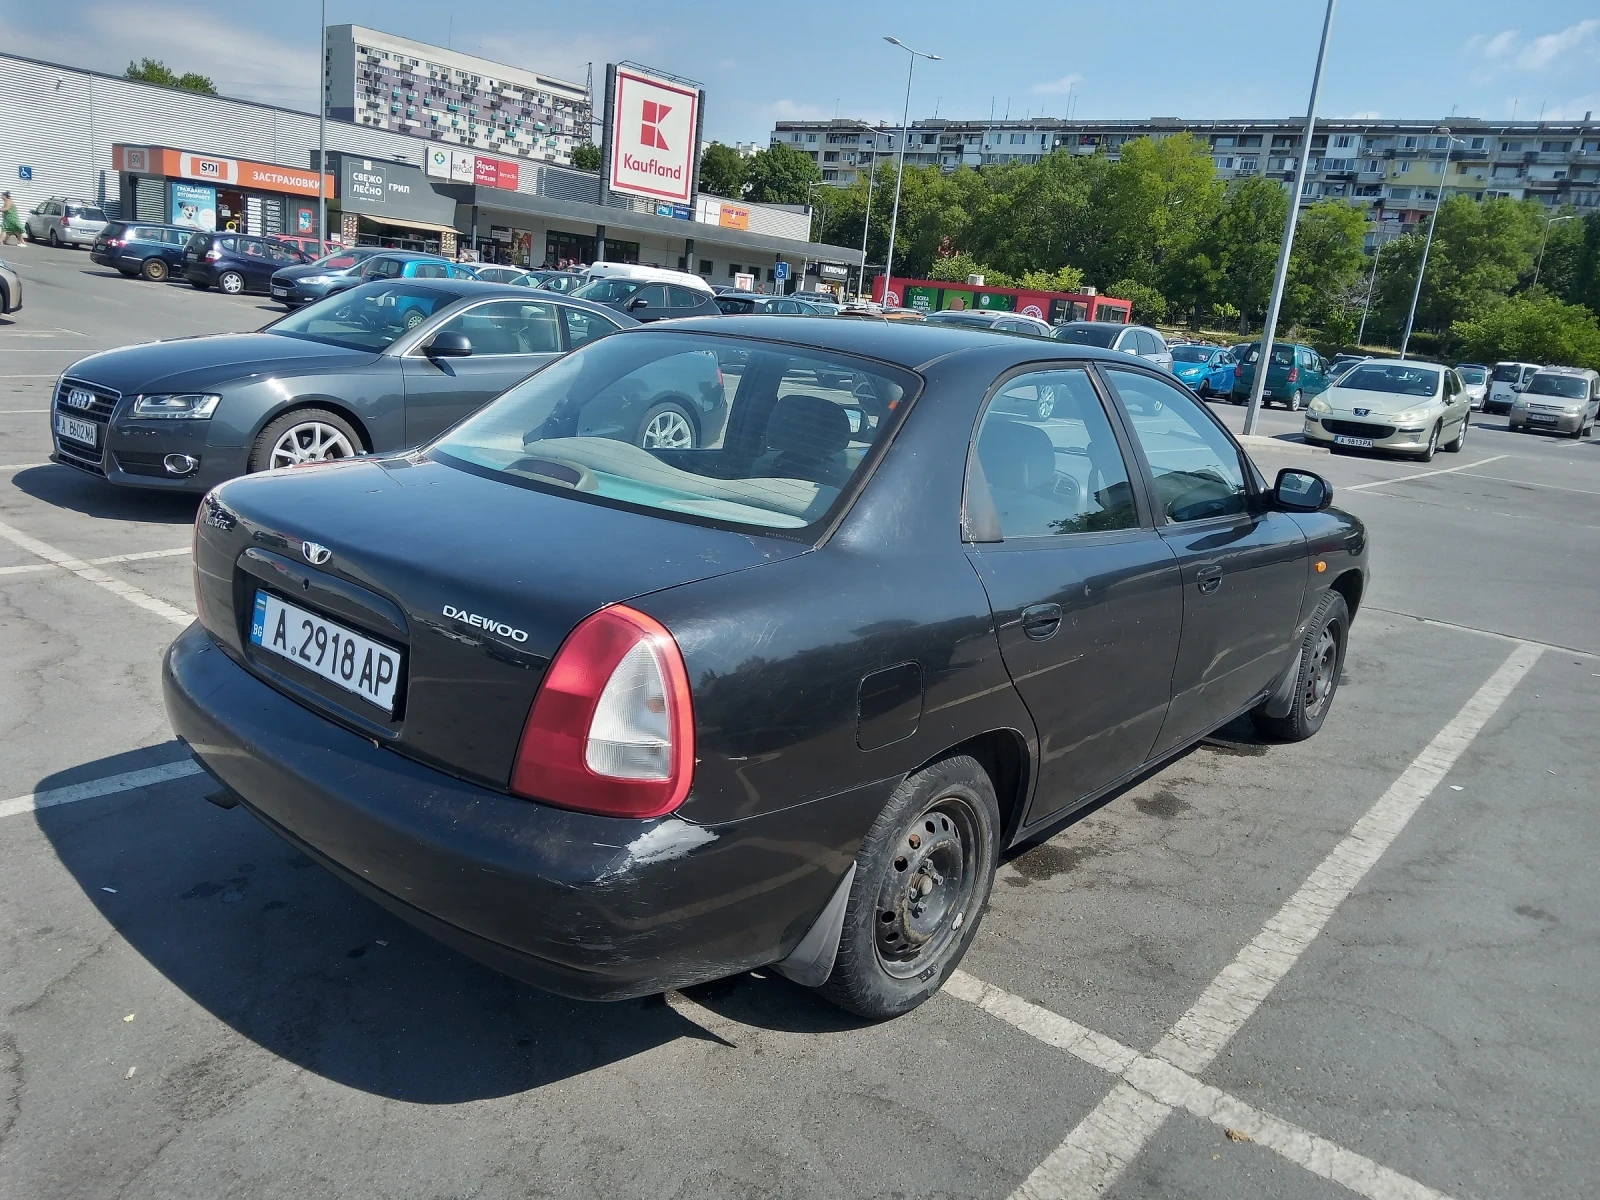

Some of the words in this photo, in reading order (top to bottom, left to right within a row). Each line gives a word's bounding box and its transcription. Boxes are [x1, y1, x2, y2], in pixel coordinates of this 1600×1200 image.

[201, 162, 218, 173] SDI
[623, 152, 682, 180] Kaufland
[352, 172, 383, 184] СВЕЖО
[352, 184, 382, 196] ЛЕСНО
[388, 182, 410, 194] ГРИЛ
[825, 264, 848, 275] КЛЮЧАР
[442, 604, 529, 642] DAEWOO
[252, 623, 263, 637] BG
